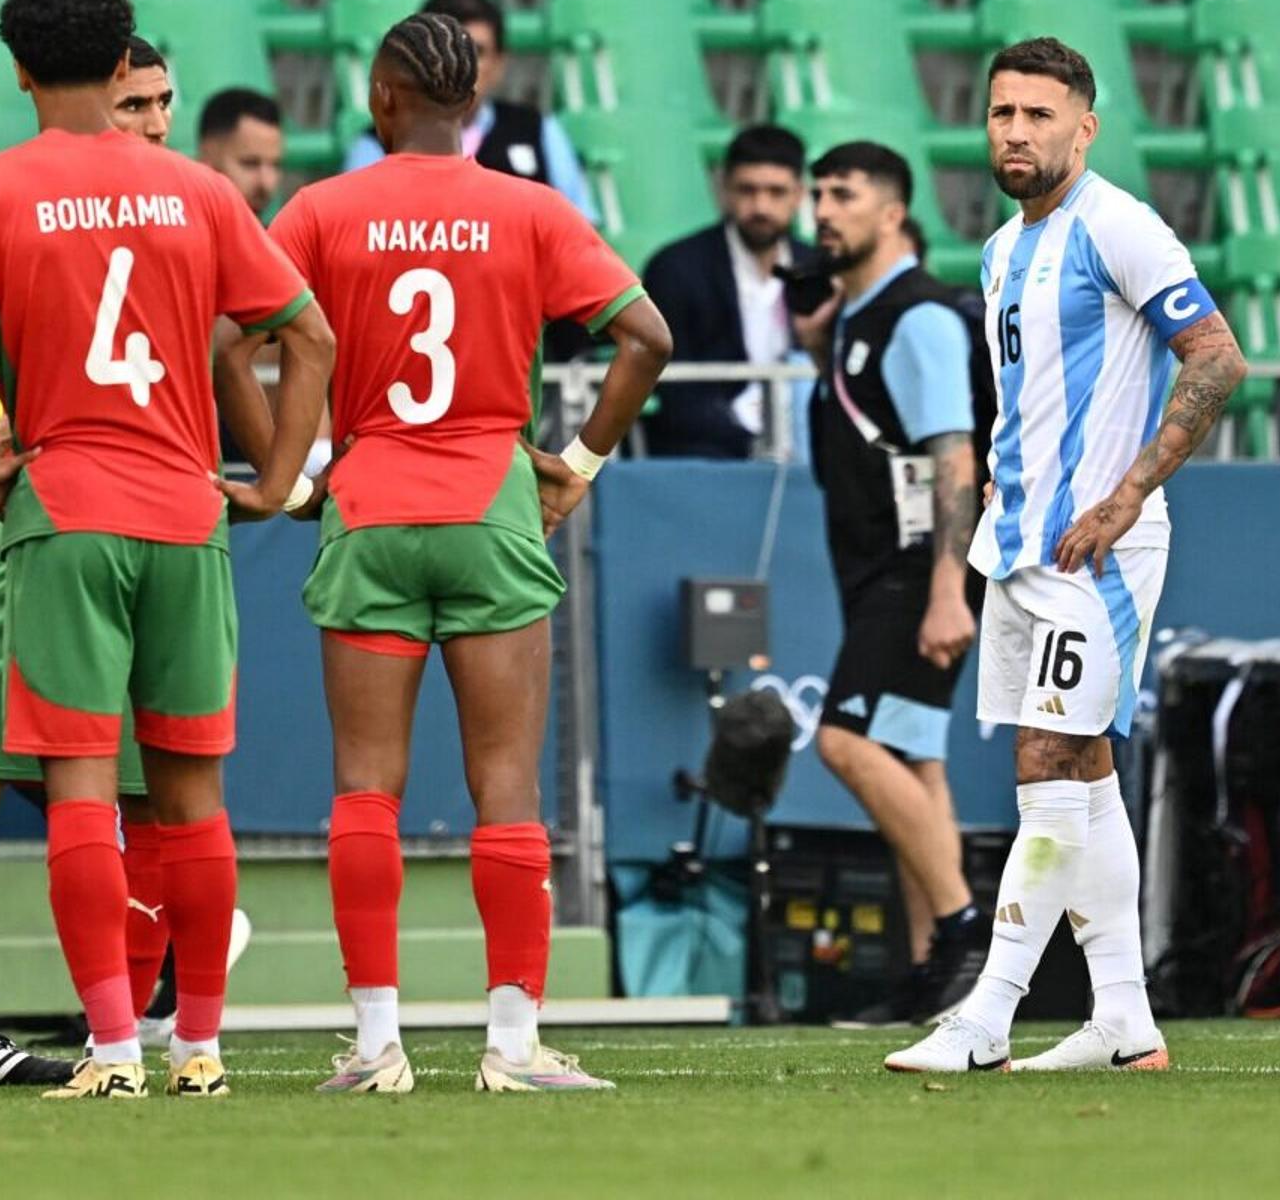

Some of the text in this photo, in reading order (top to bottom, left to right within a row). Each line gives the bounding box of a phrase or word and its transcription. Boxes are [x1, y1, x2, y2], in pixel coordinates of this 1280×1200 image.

[36, 195, 186, 233] BOUKAMIR
[368, 219, 489, 252] NAKACH
[85, 246, 166, 408] 4
[998, 303, 1022, 367] 16
[1163, 287, 1200, 321] C
[387, 268, 456, 425] 3
[1037, 629, 1087, 691] 16
